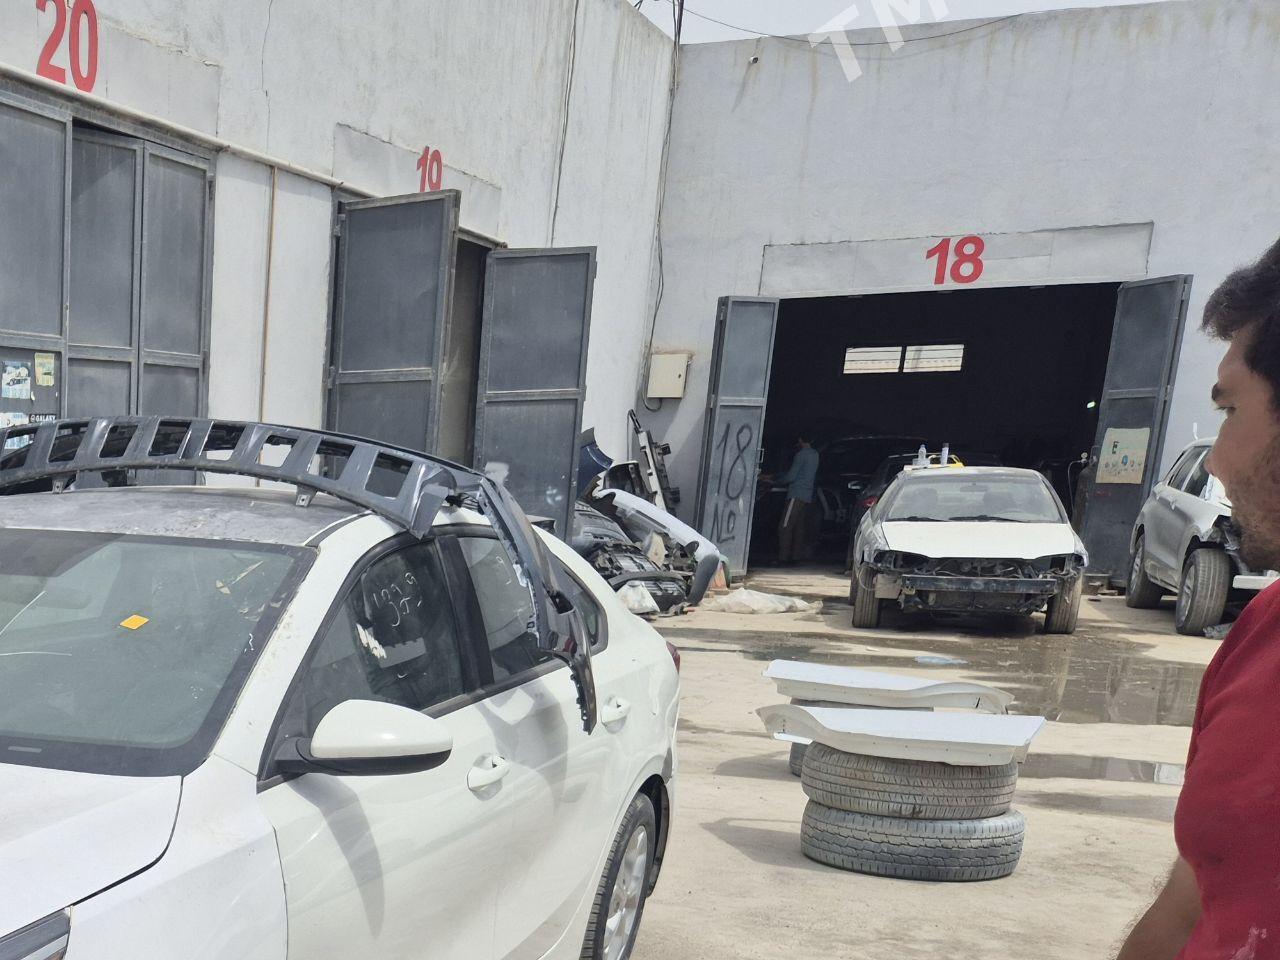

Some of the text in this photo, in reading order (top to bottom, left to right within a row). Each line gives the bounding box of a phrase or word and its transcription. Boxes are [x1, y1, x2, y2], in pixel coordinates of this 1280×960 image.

[36, 0, 99, 93] 20
[926, 235, 985, 285] 18
[716, 422, 753, 500] 18
